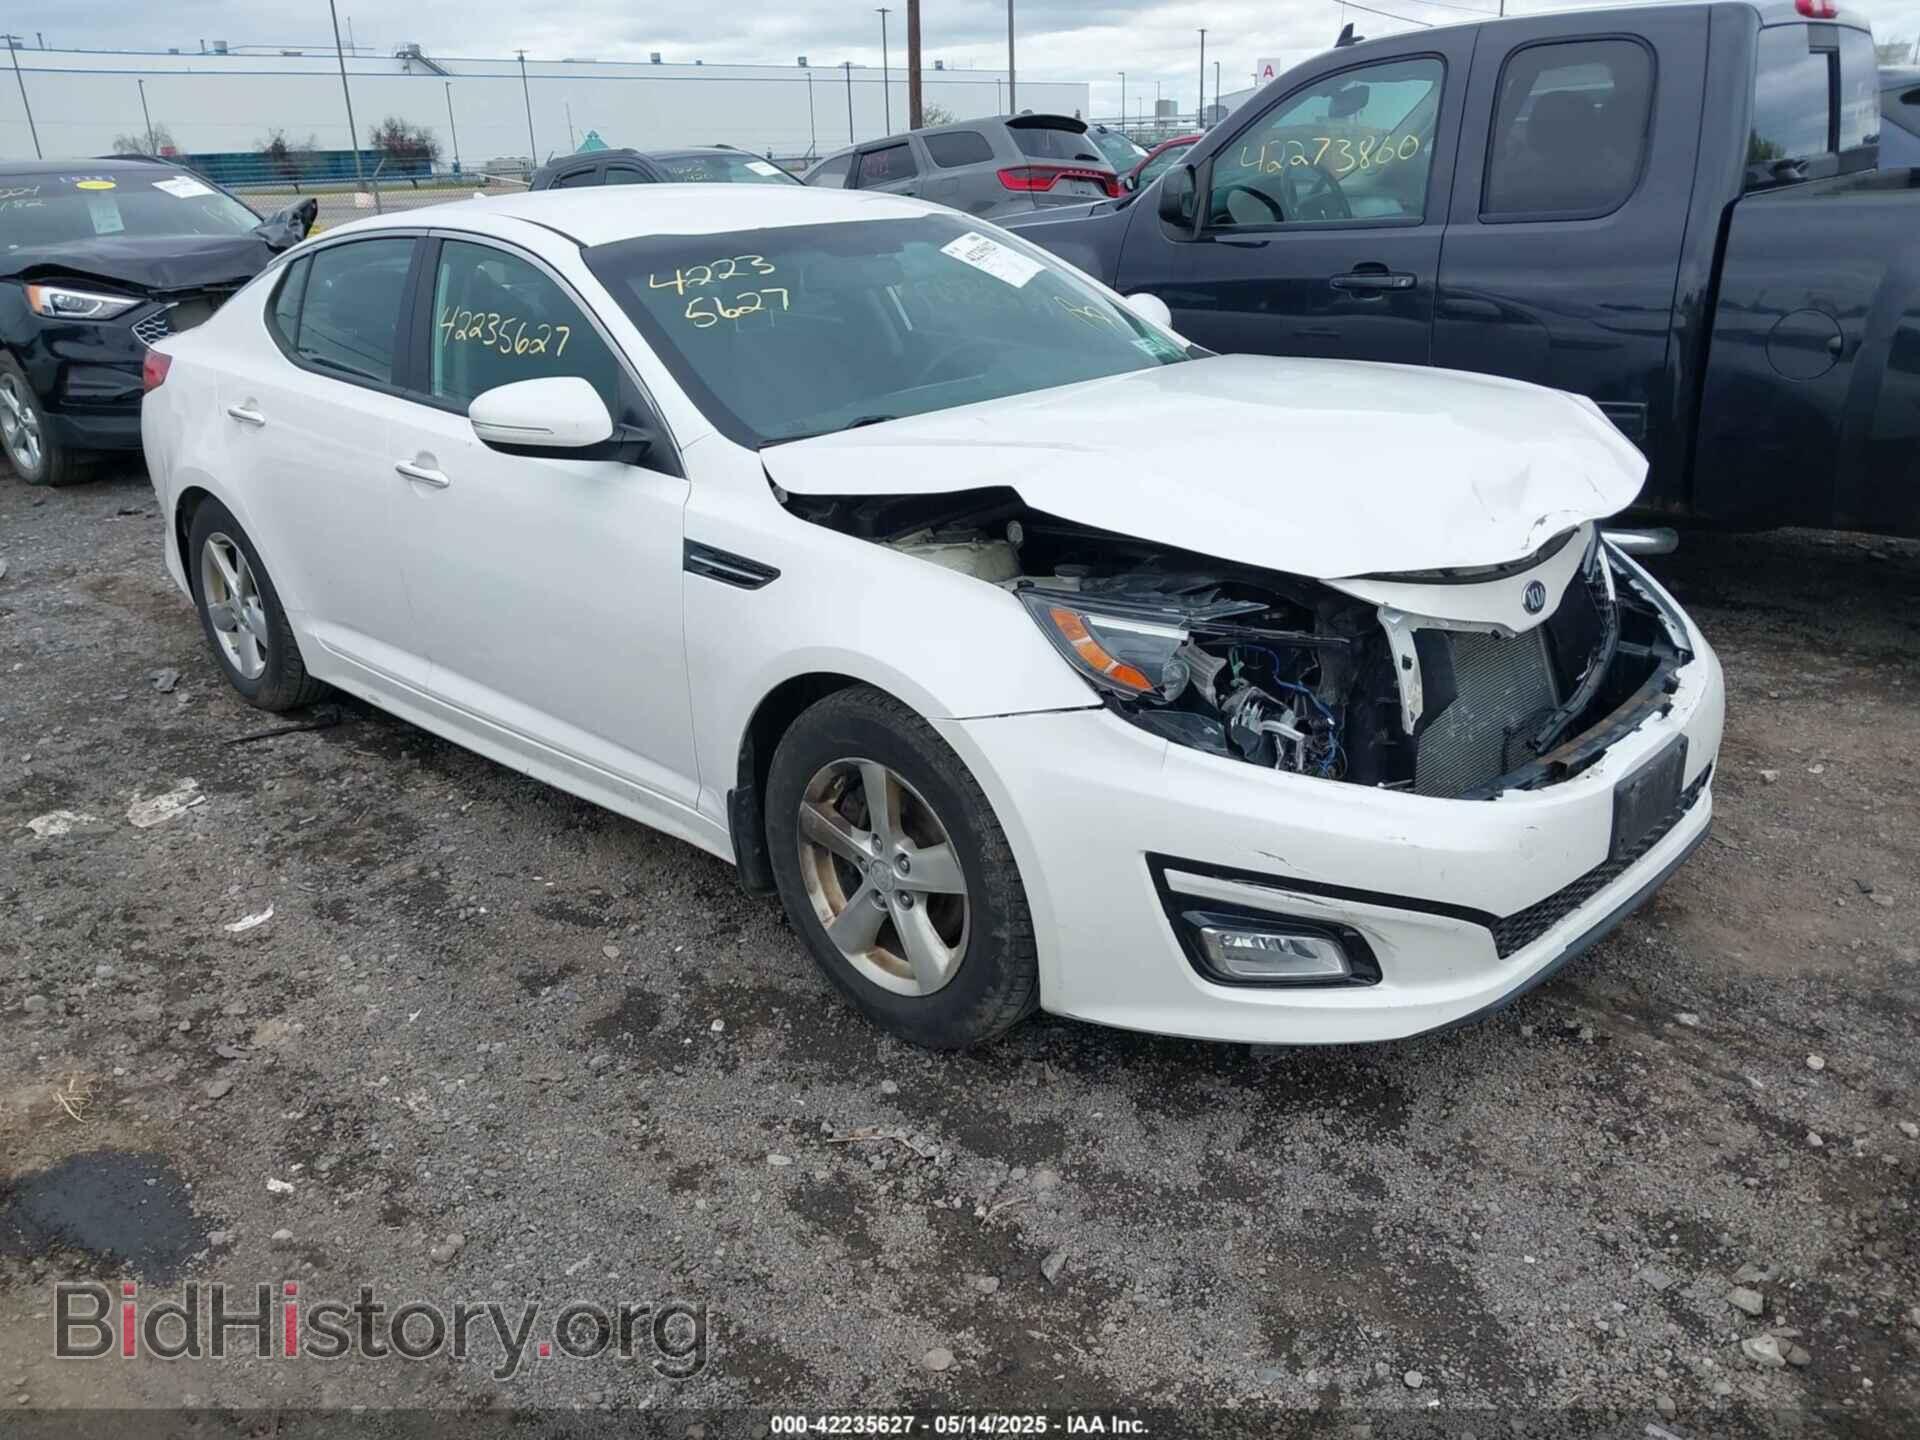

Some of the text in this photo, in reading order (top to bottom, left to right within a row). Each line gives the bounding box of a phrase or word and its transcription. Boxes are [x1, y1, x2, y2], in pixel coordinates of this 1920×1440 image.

[1263, 64, 1274, 78] A
[1240, 135, 1419, 173] 42273860
[650, 255, 776, 295] 4223
[685, 288, 790, 328] 5627
[440, 305, 570, 357] 42235627
